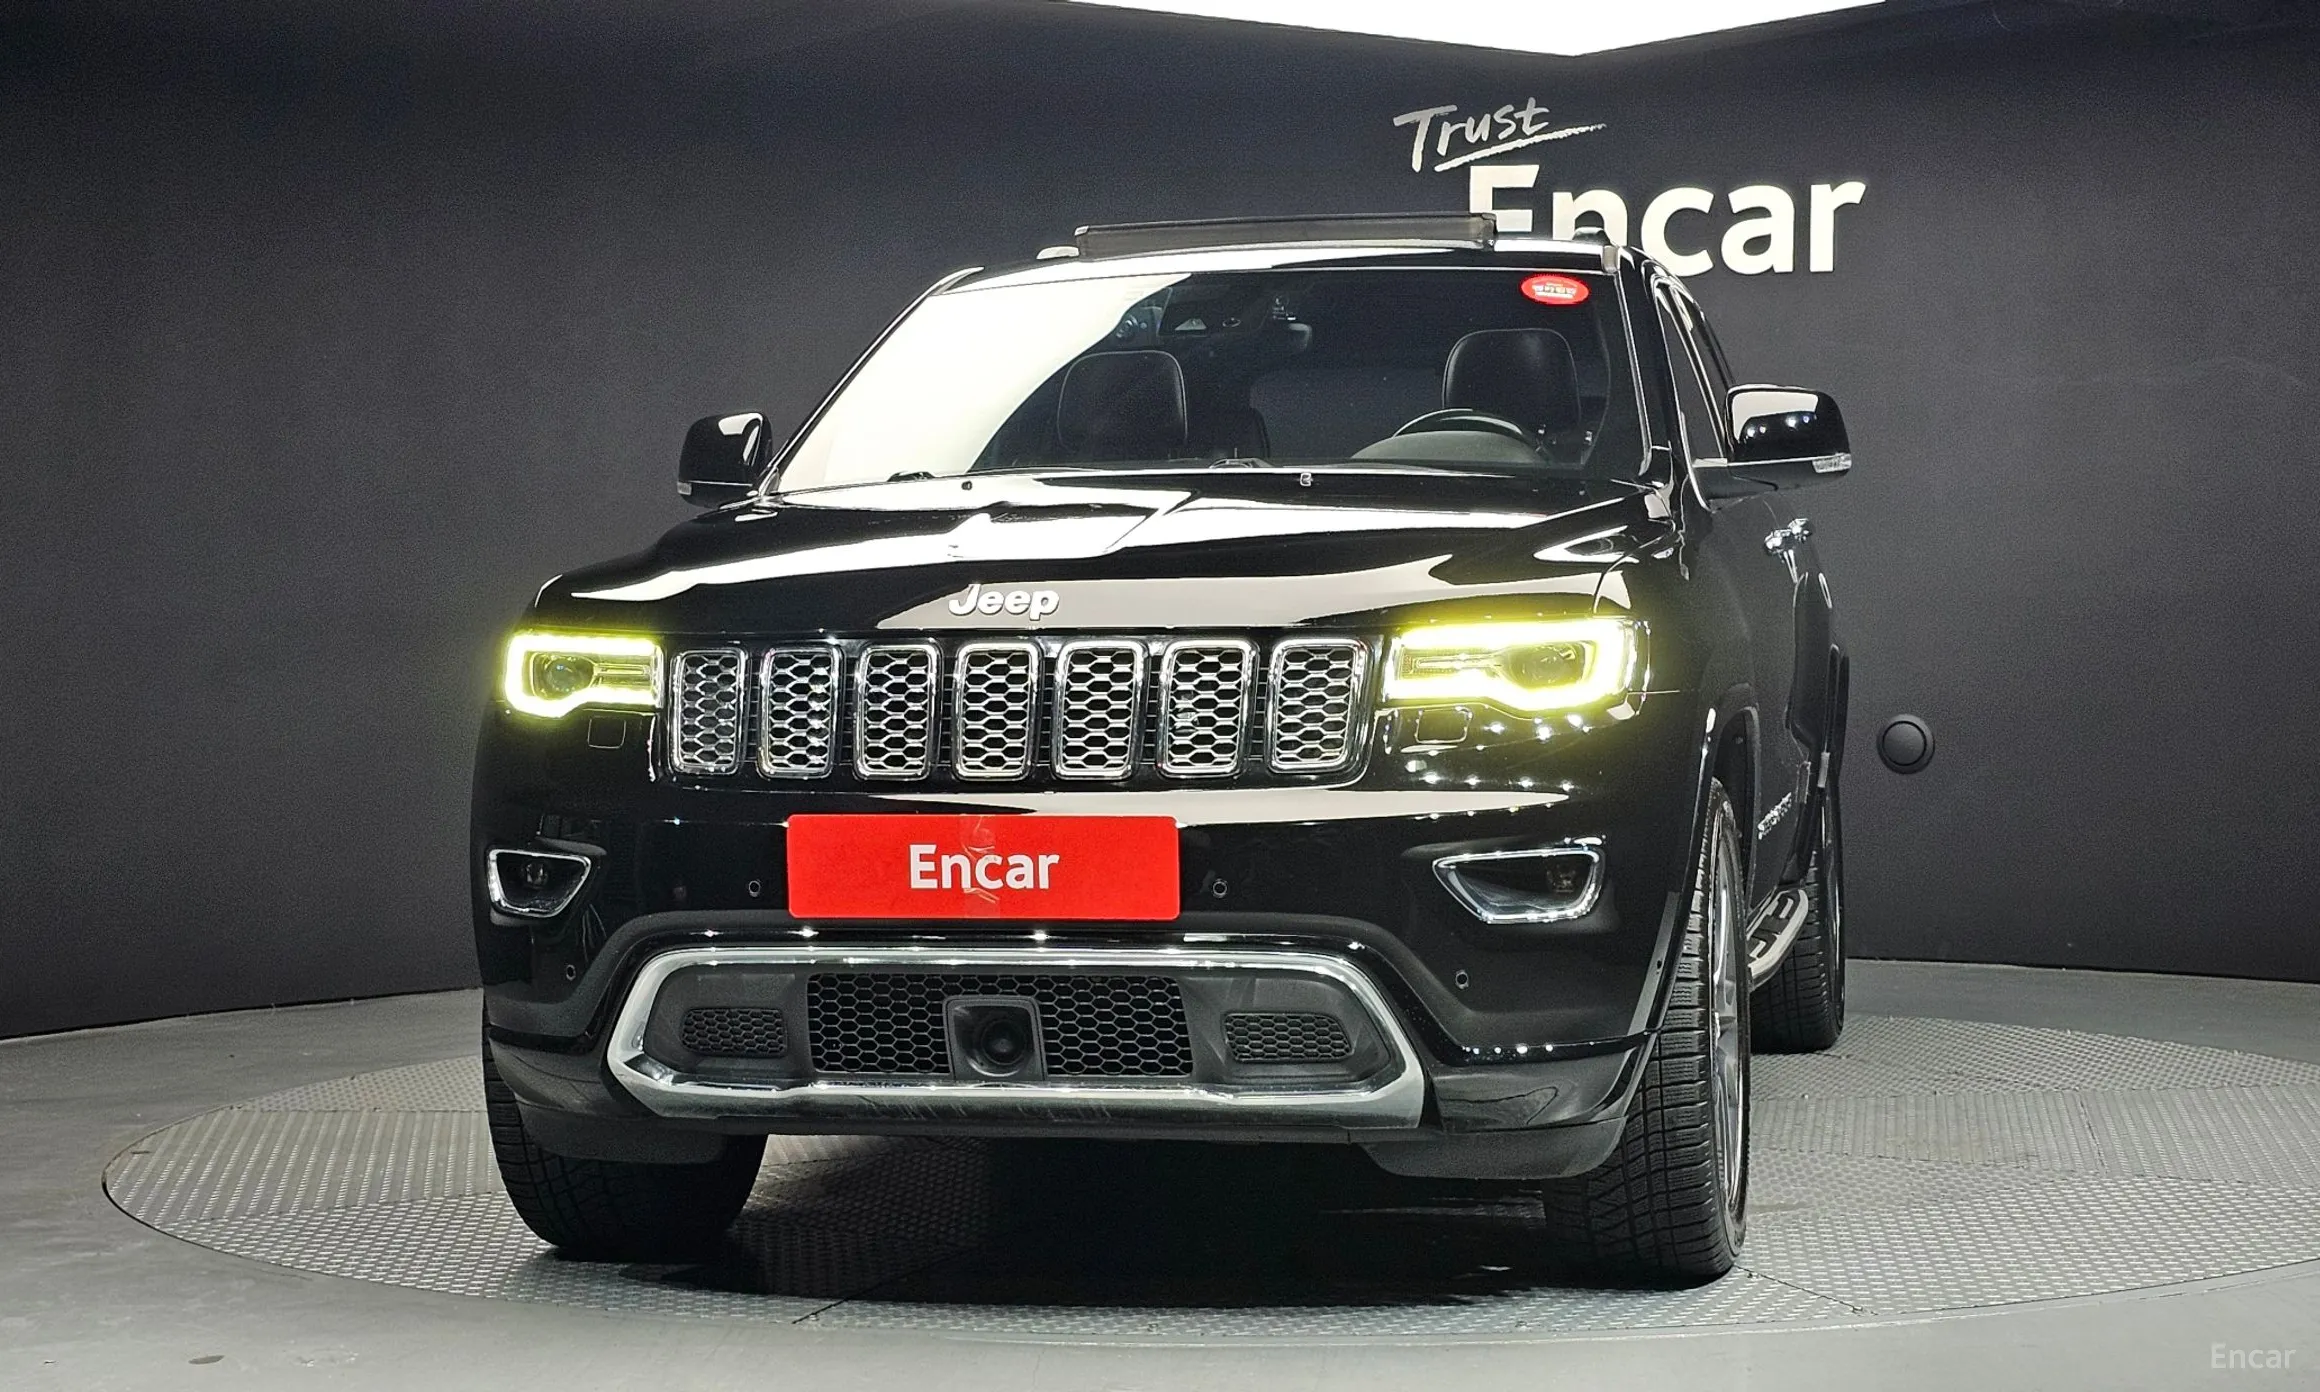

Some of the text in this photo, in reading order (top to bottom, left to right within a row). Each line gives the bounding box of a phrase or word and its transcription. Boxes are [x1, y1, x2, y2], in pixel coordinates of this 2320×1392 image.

[1393, 97, 1550, 172] Trust
[1468, 163, 1867, 277] Encar
[948, 583, 1060, 621] Jeep
[909, 843, 1061, 890] Encar
